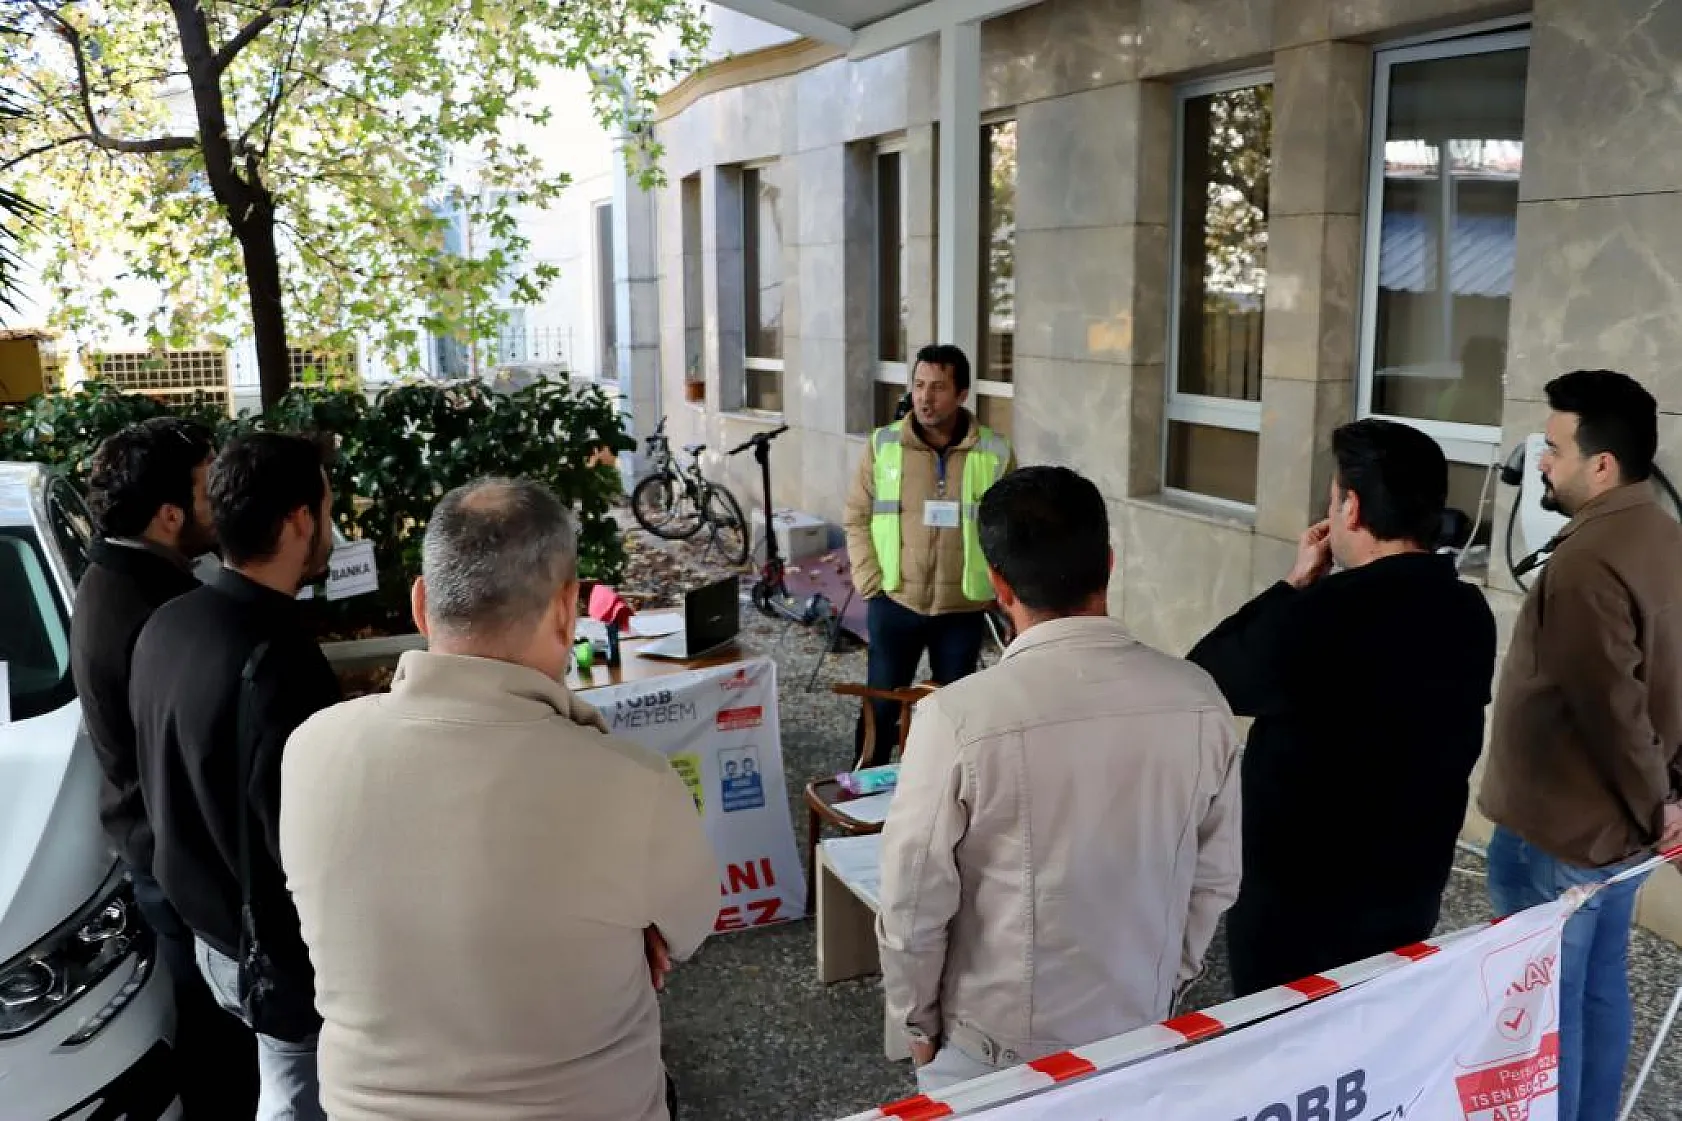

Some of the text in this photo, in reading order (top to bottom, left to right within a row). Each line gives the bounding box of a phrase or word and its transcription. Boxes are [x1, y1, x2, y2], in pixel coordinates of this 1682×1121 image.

[331, 562, 371, 582] BANKA
[613, 701, 697, 729] MEYBEM
[720, 857, 775, 895] NI
